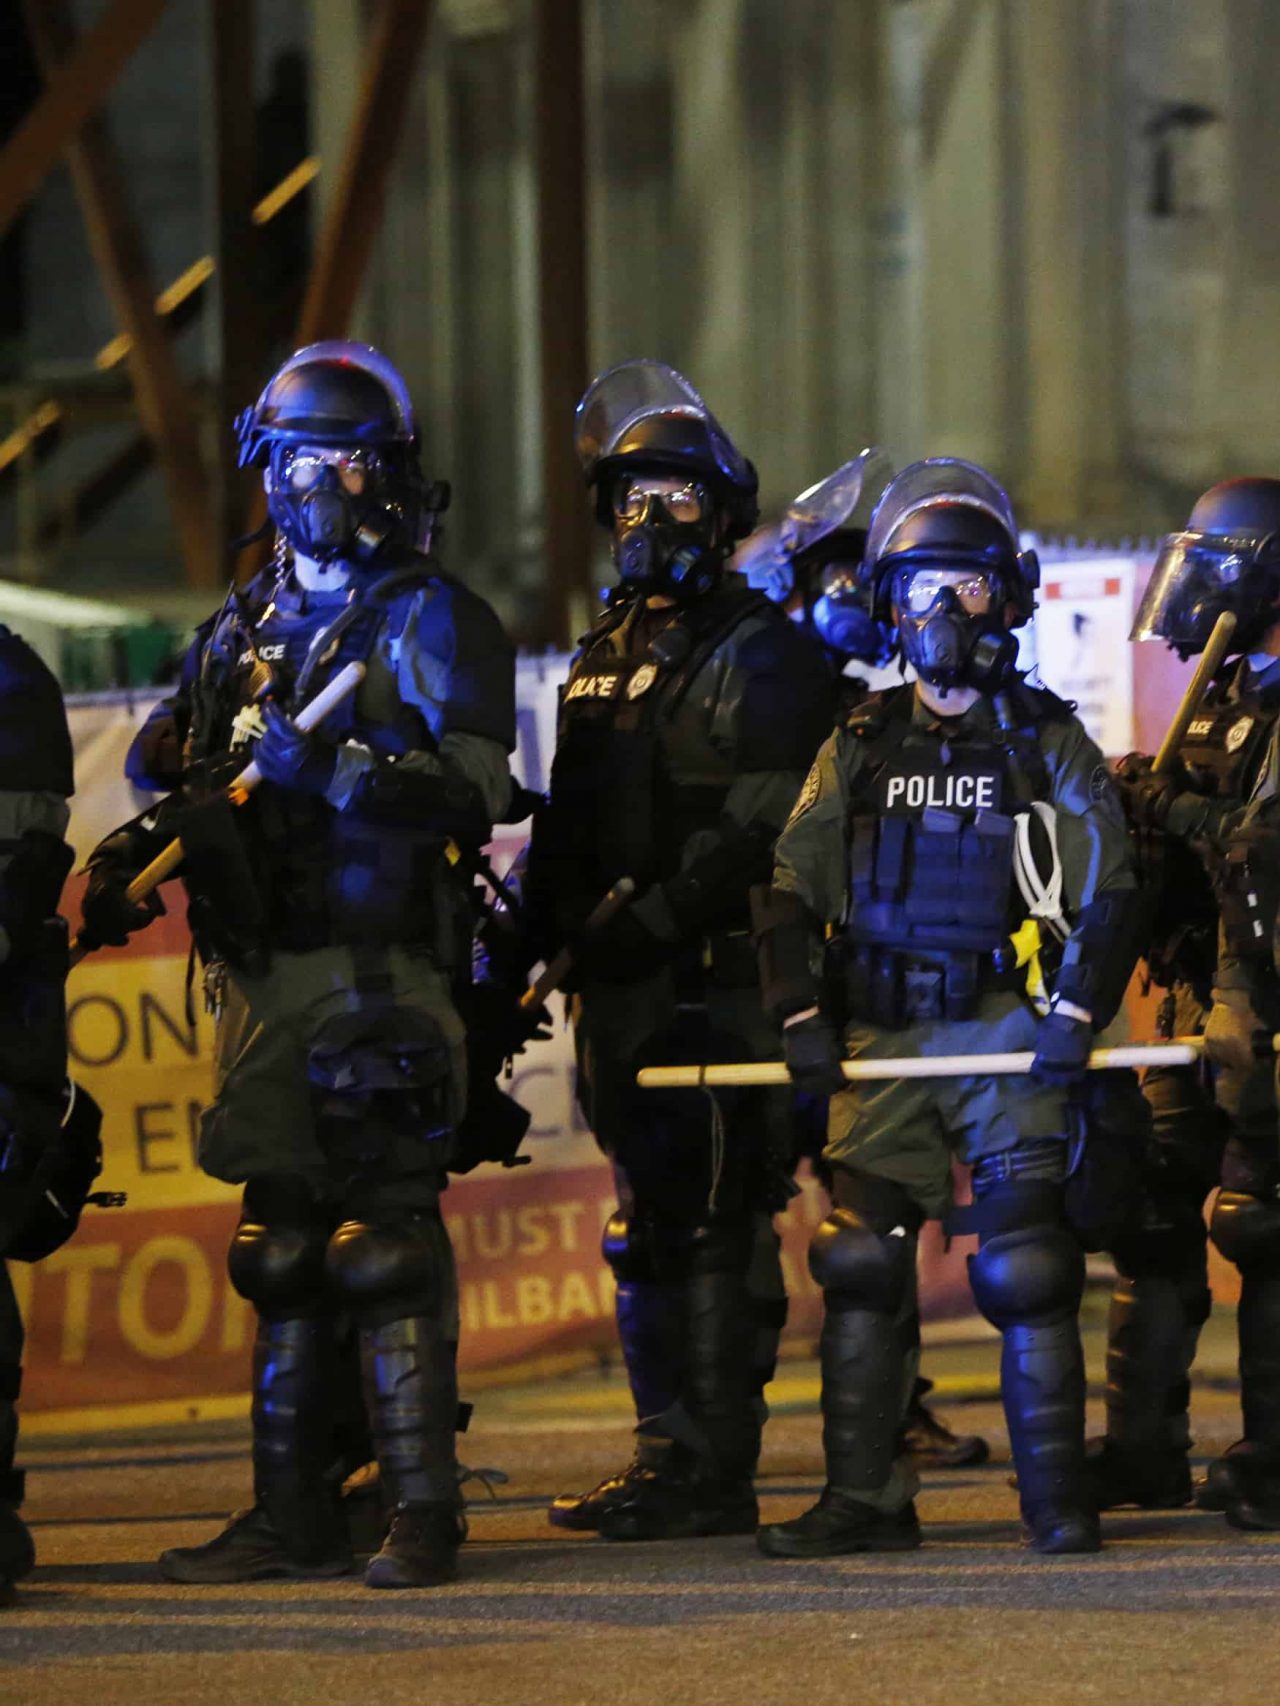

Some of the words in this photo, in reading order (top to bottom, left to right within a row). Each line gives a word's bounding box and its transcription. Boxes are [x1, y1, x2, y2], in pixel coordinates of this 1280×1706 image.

[238, 644, 286, 665] POICE
[887, 775, 994, 808] POLICE
[135, 1099, 204, 1174] E
